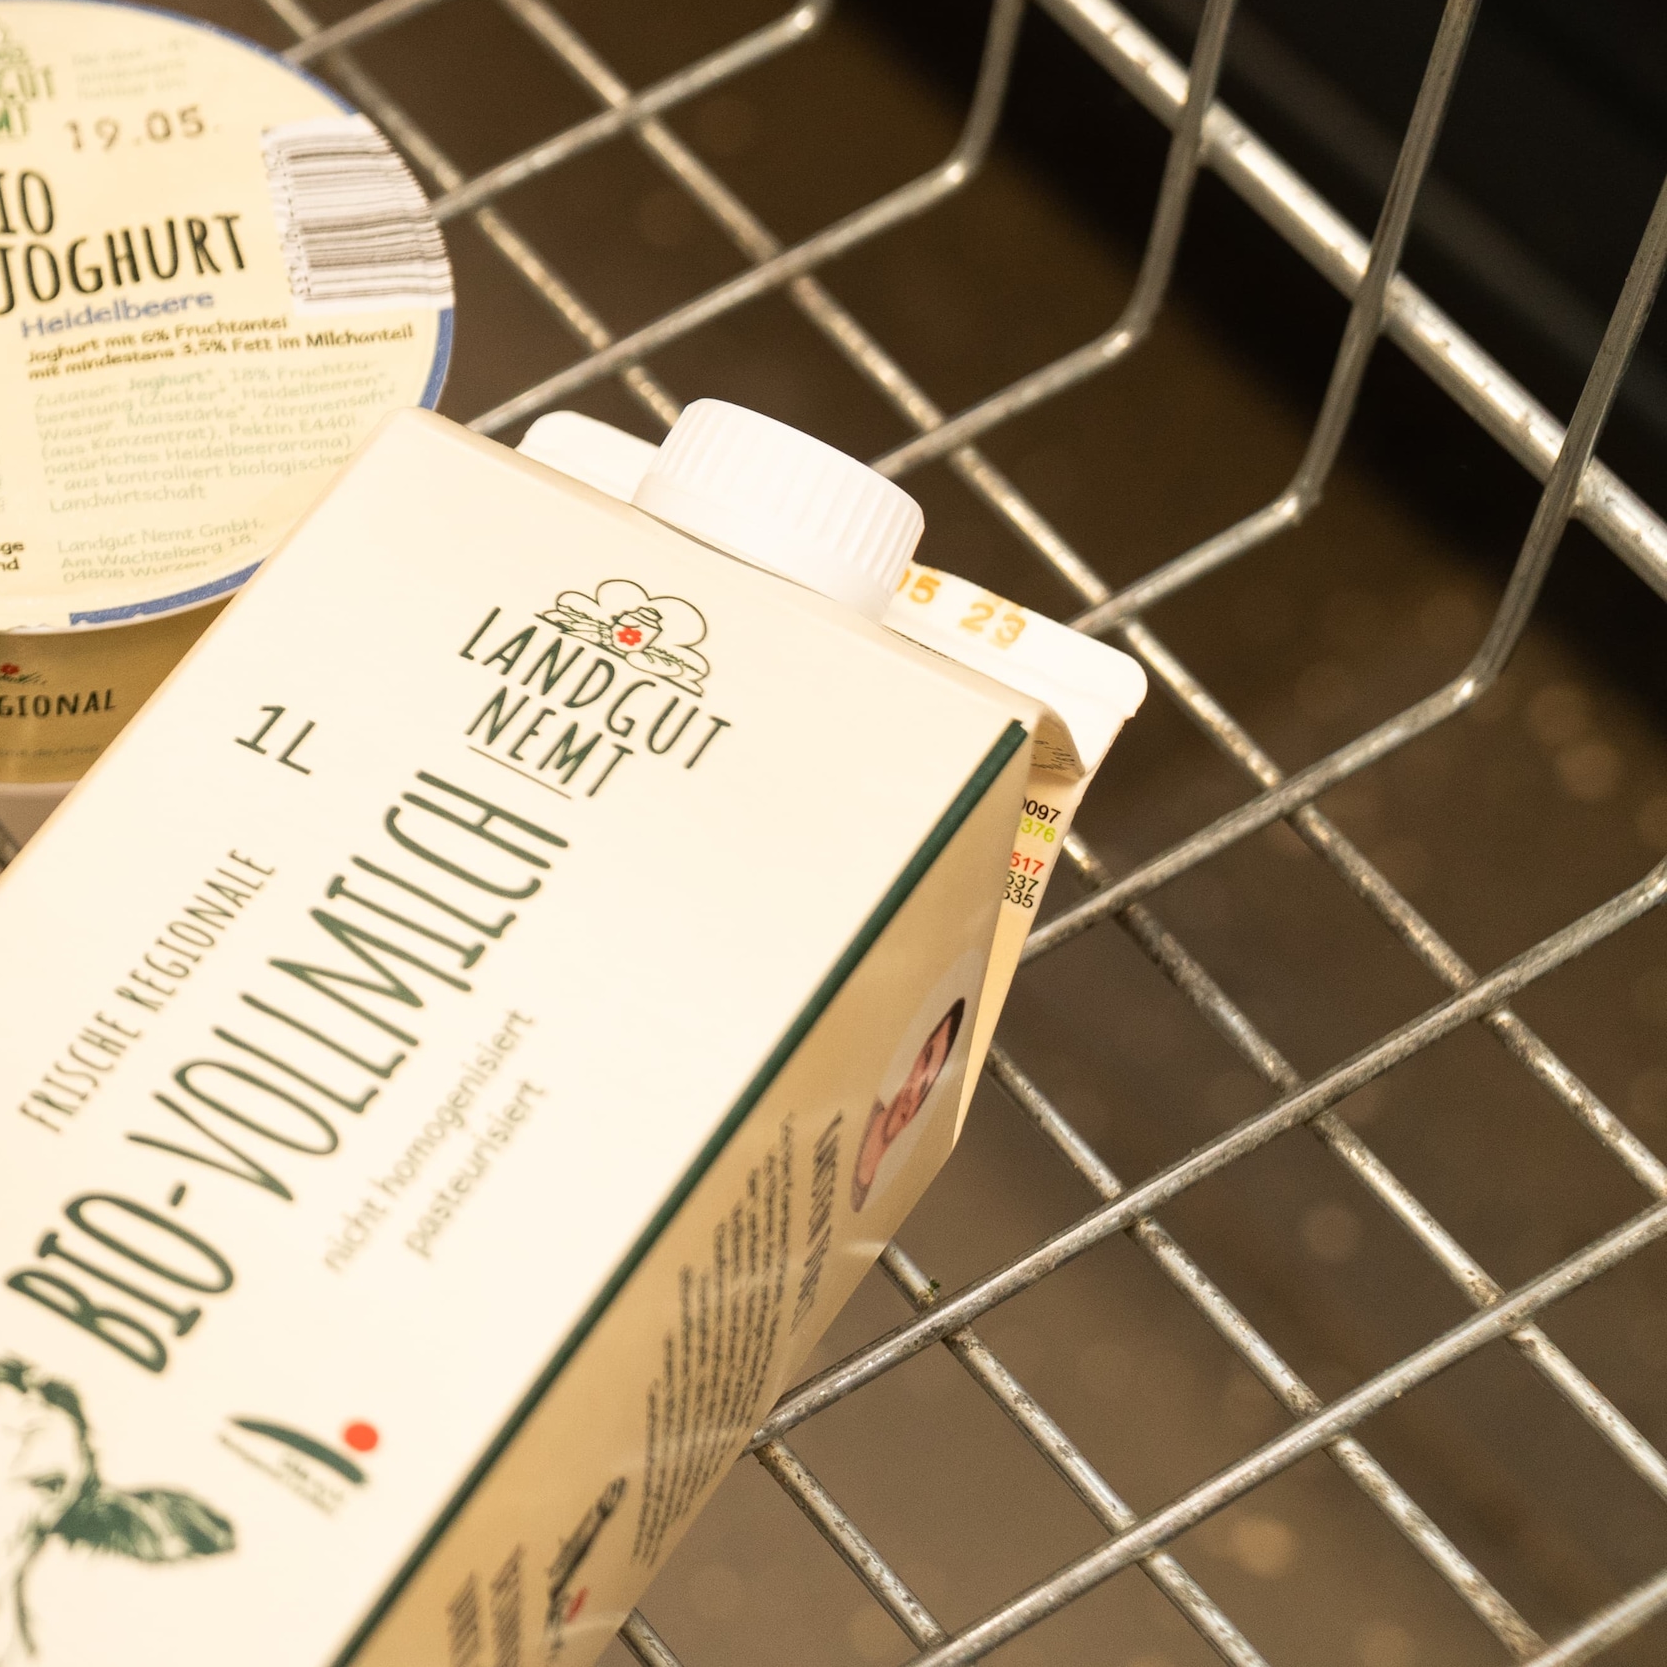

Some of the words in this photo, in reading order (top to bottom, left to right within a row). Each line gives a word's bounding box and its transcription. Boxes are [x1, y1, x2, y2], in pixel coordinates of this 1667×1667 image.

[22, 293, 214, 338] Heidelbeere
[235, 705, 316, 776] 1L
[459, 606, 732, 770] LANDGUT
[465, 686, 634, 798] NEMT
[19, 1012, 141, 1133] FRISCHE
[115, 849, 275, 1013] REGIONALE
[4, 770, 570, 1376] BIO-VOLLMILCH
[323, 1198, 388, 1273] nicht
[404, 1080, 545, 1260] pasteurisiert
